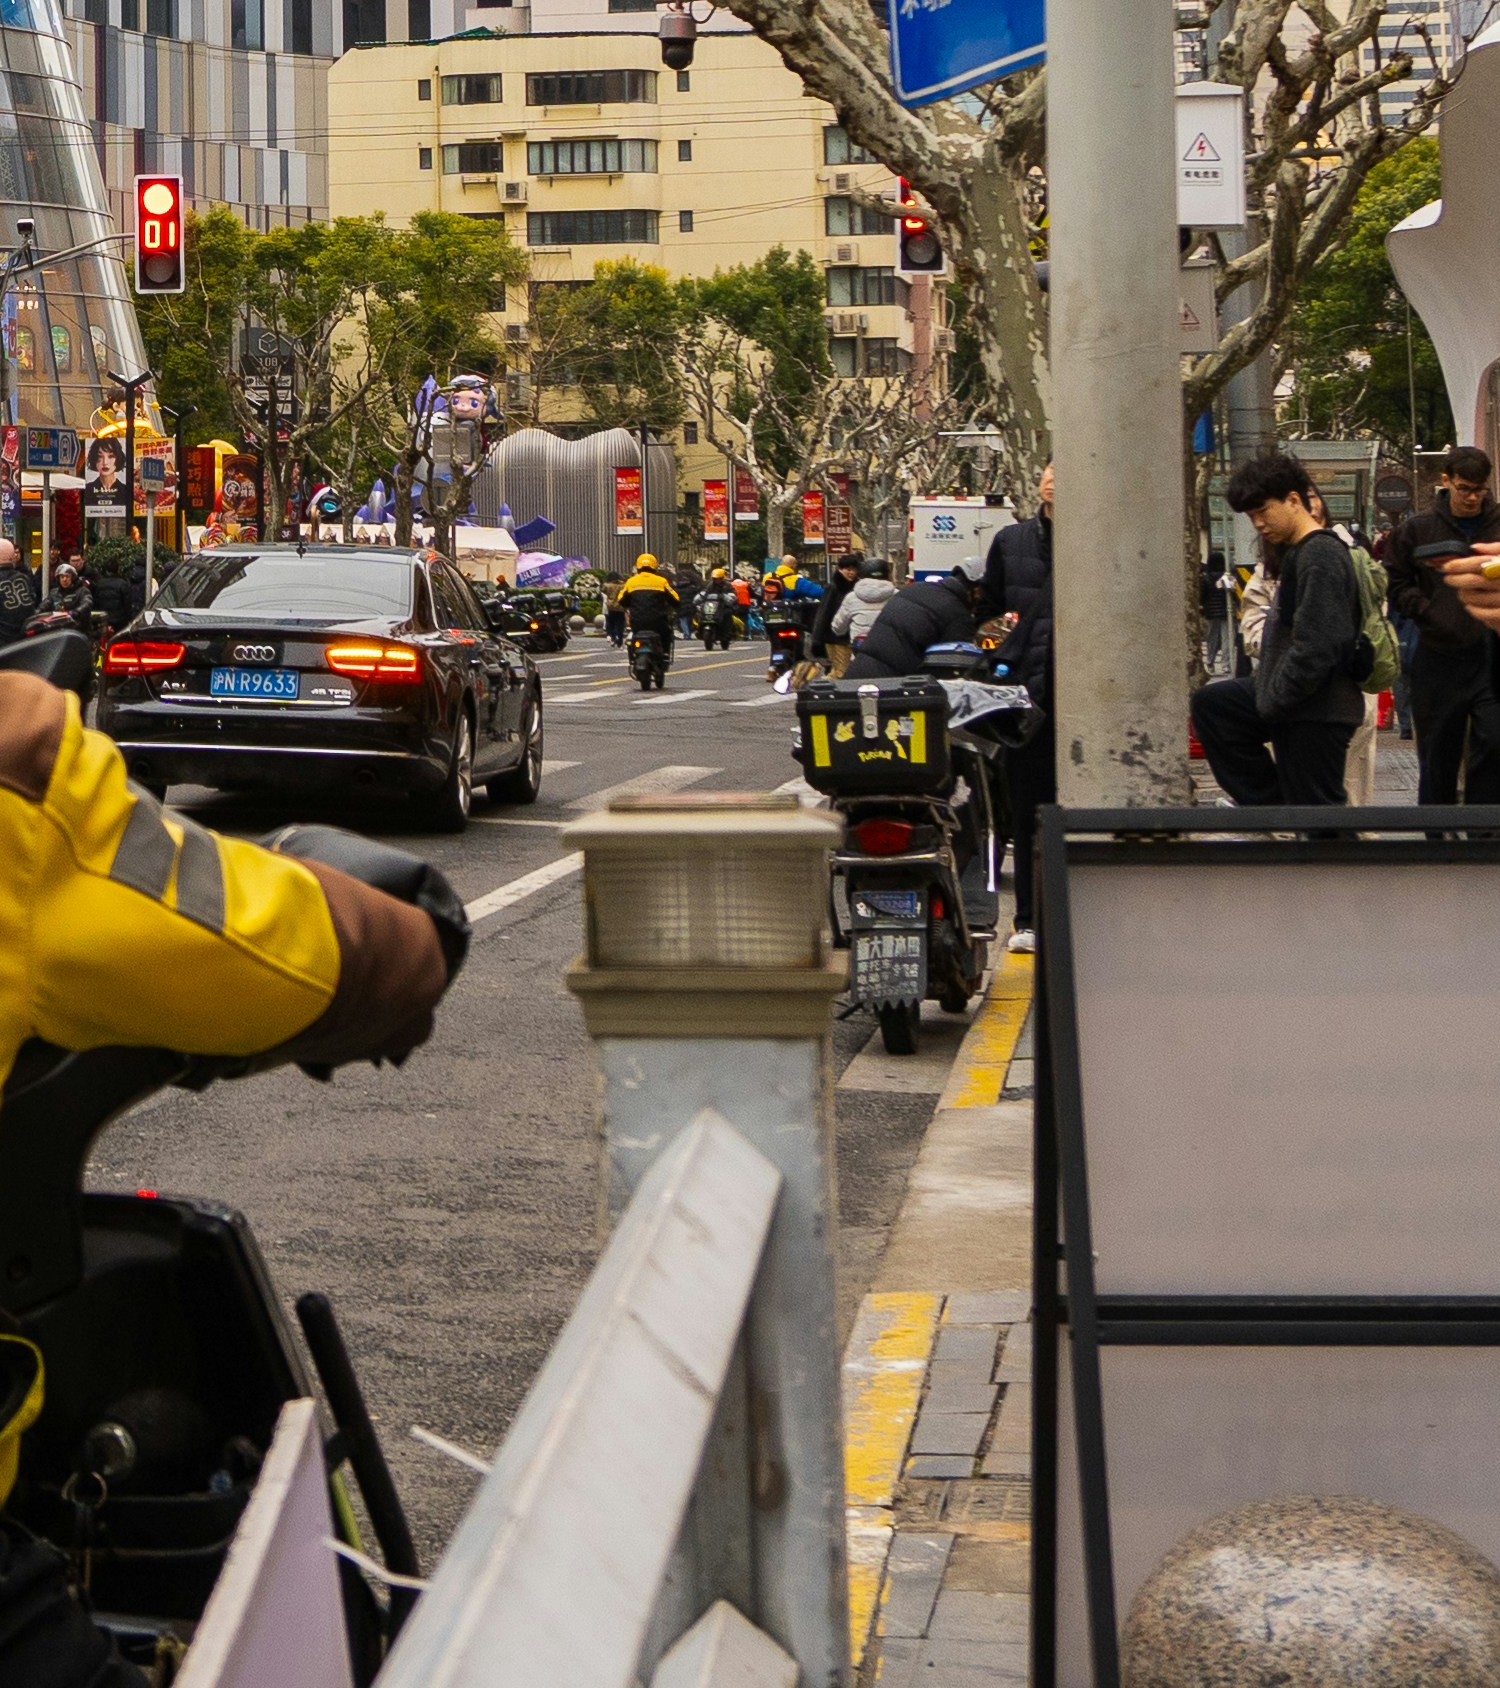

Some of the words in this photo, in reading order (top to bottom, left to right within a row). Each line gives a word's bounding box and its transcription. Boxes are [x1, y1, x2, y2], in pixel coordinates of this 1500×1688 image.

[144, 220, 176, 249] 01
[0, 577, 33, 610] 32
[212, 671, 297, 695] 沪N·R9633
